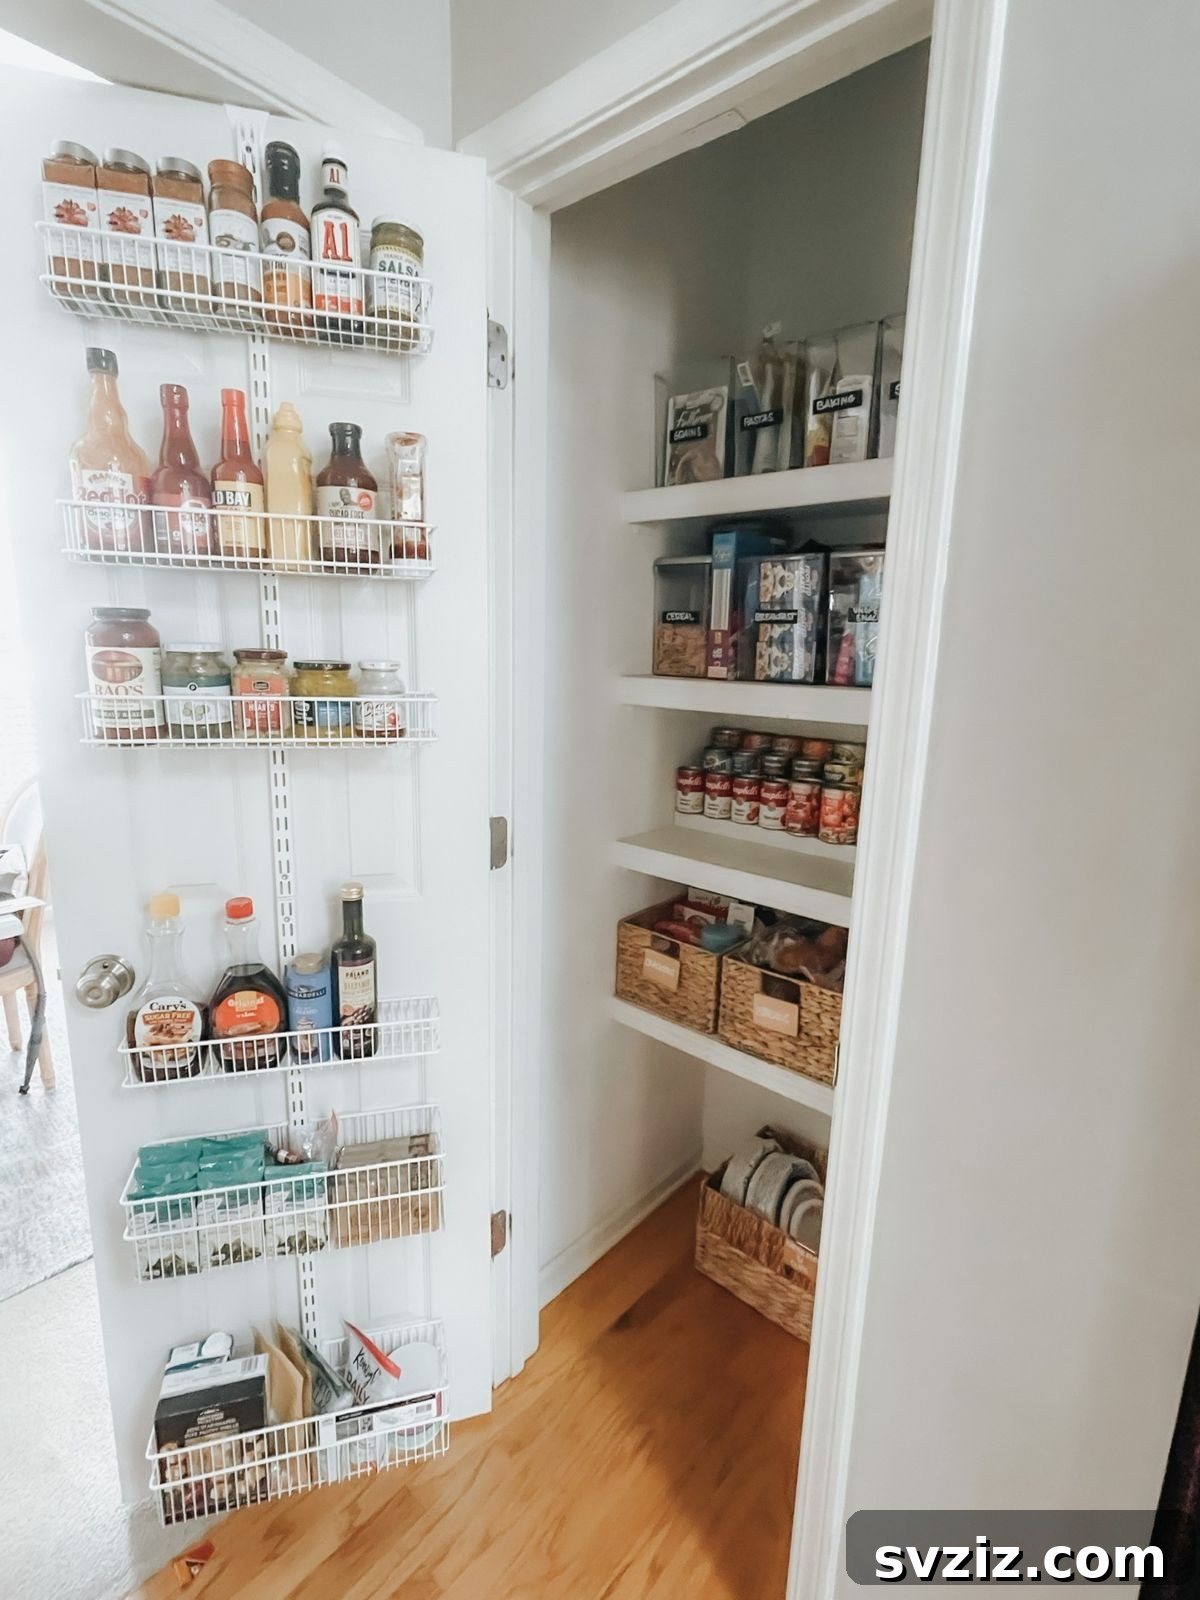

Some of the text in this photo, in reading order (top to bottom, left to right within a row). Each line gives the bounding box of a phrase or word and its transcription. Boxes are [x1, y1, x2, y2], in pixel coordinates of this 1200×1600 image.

[378, 259, 419, 277] SALSA
[816, 394, 856, 411] BAKING
[211, 490, 251, 507] LD BAY
[149, 1000, 187, 1012] Cary's
[143, 1011, 193, 1021] SUGAR FREE
